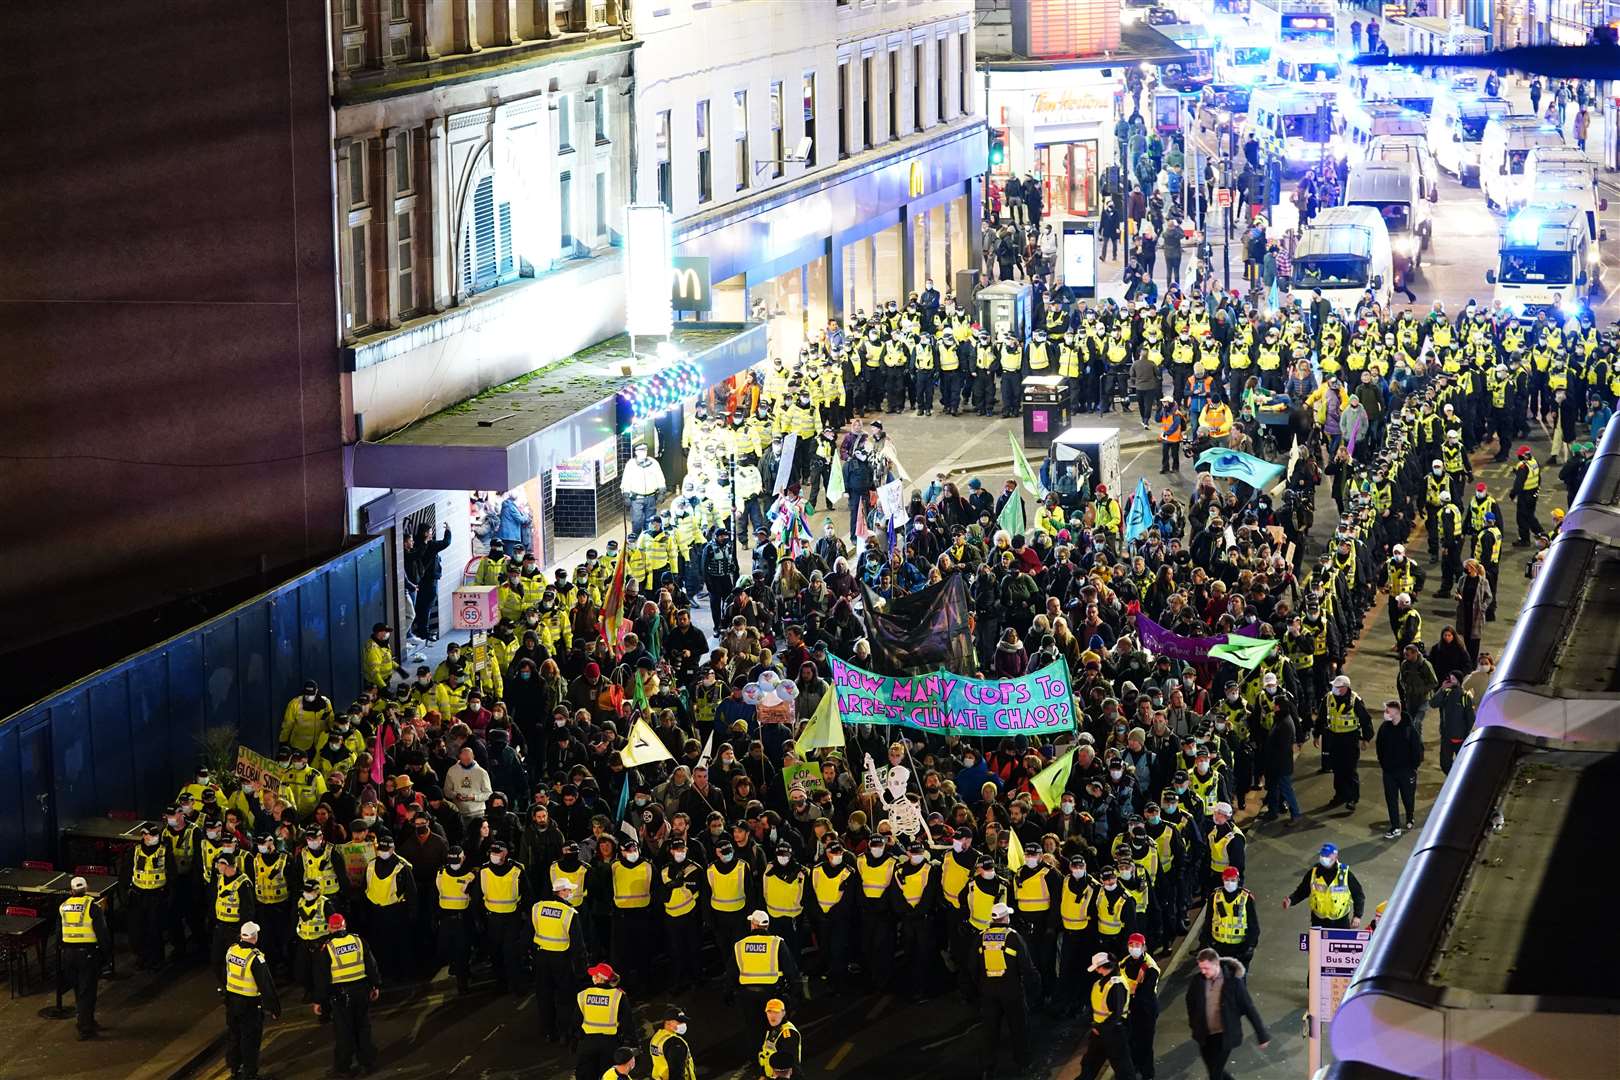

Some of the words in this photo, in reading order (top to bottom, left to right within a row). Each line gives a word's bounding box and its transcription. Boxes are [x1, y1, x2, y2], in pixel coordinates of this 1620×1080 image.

[465, 610, 478, 620] 55
[832, 659, 886, 696] HOW
[892, 675, 957, 702] MANY
[964, 682, 1031, 705] COPS
[1035, 675, 1065, 699] TO
[837, 694, 905, 721] ARREST
[994, 703, 1070, 729] CHAOS?
[542, 907, 561, 917] POLICE
[337, 945, 357, 954] POLICE
[746, 943, 767, 952] POLICE
[230, 956, 246, 967] POLICE
[1345, 956, 1361, 964] Sto
[587, 996, 608, 1005] POLICE
